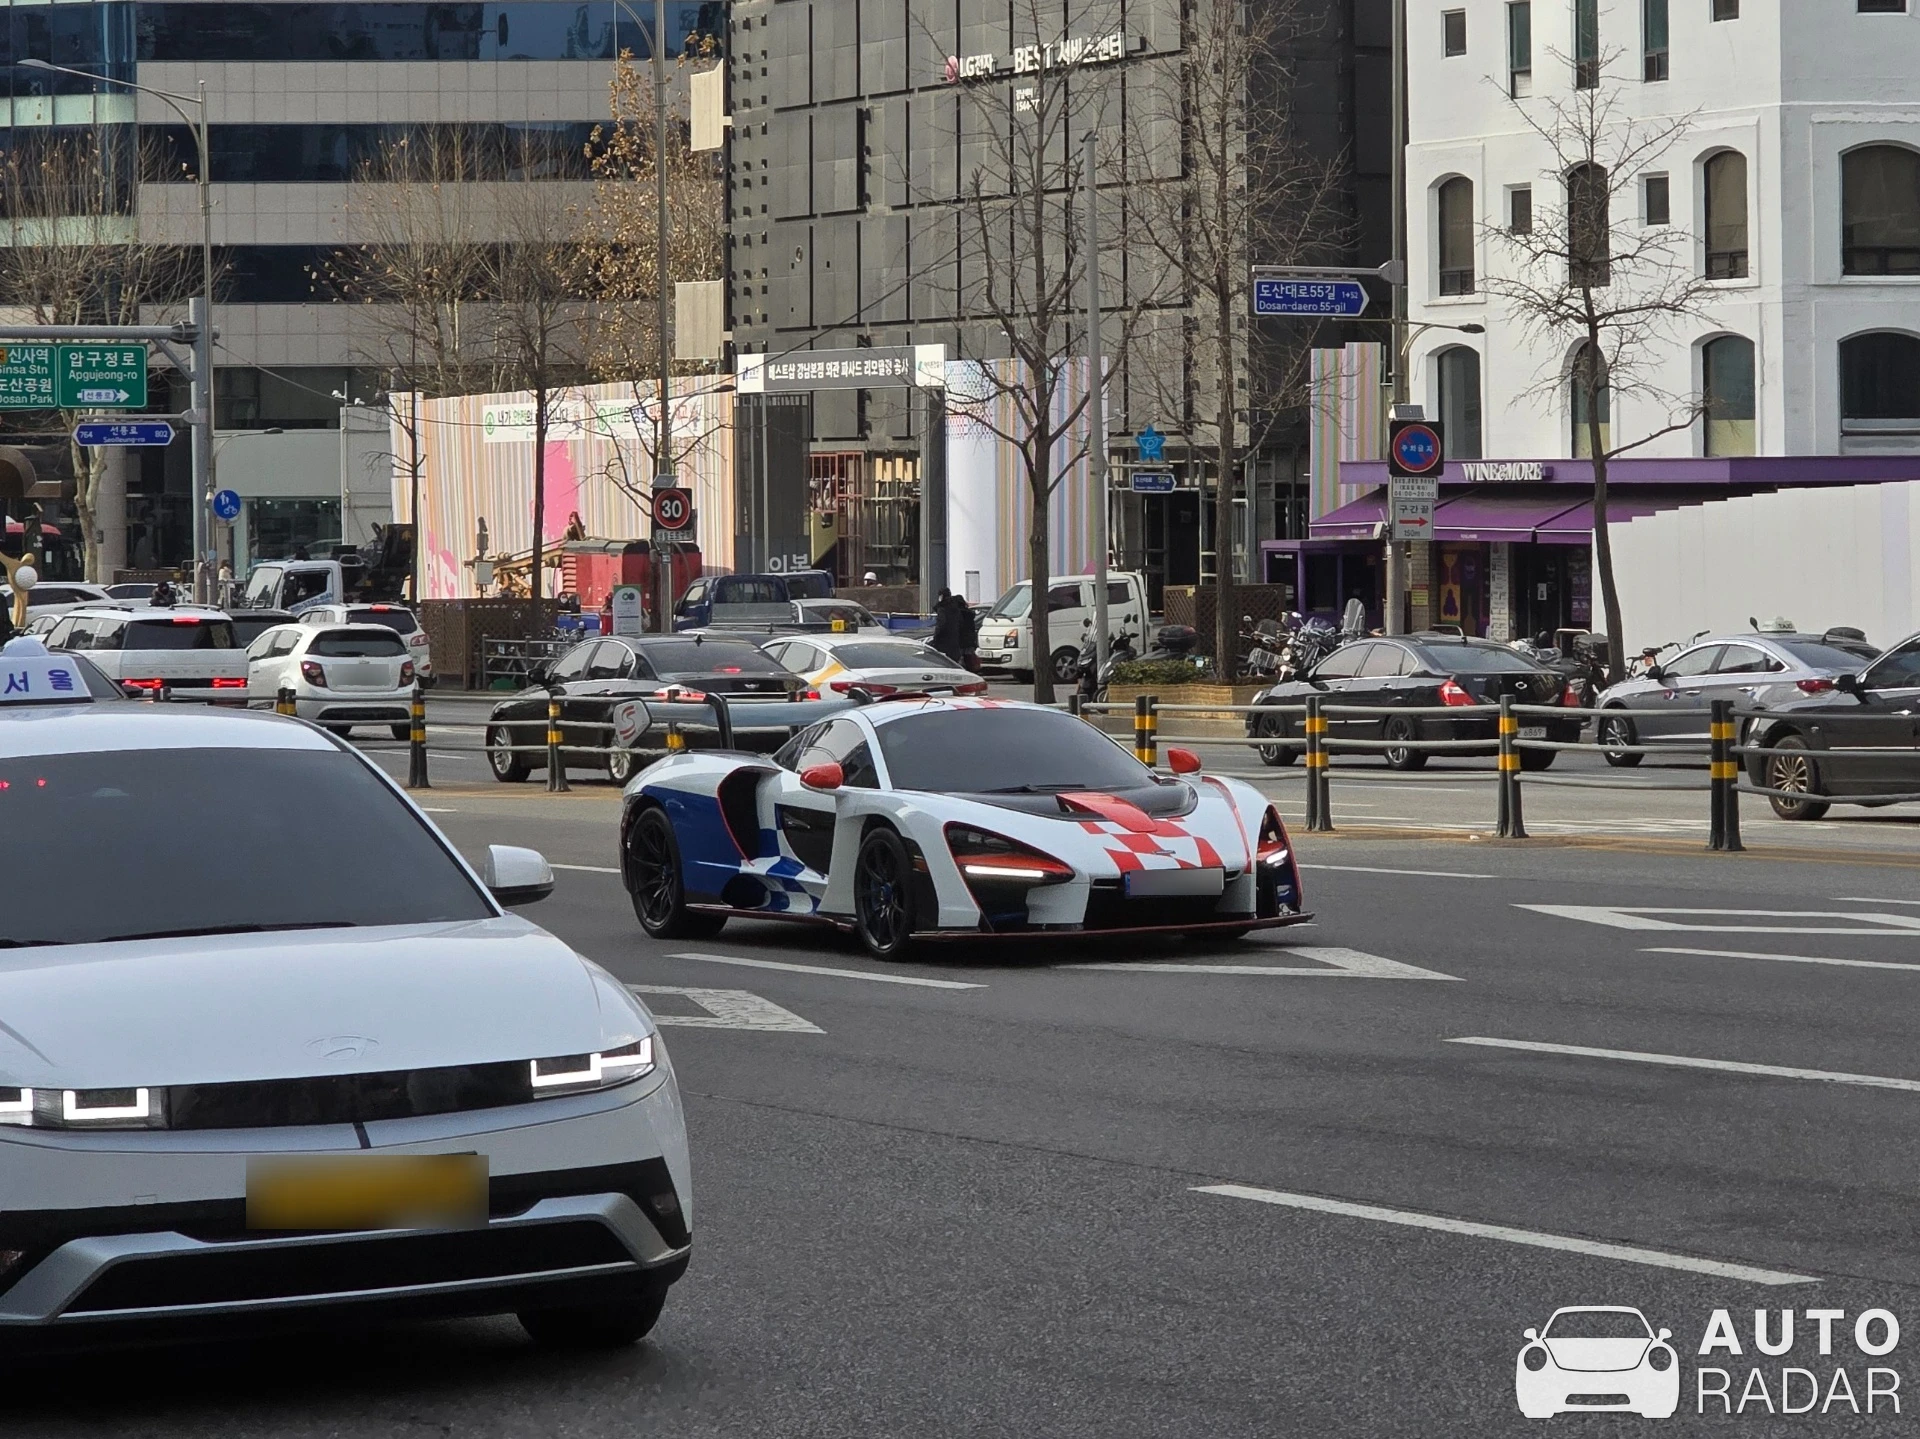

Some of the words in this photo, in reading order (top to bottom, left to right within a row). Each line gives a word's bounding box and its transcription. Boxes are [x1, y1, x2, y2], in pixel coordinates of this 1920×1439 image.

[959, 53, 993, 78] LG전자
[1013, 43, 1054, 73] BEST
[1057, 31, 1124, 66] 서비스센터
[1259, 284, 1336, 300] 도산대로55길
[1259, 300, 1318, 311] Dosan-daero
[1319, 302, 1347, 313] 55-gil
[8, 348, 49, 364] 신사역
[69, 351, 137, 368] 압구정로
[29, 364, 48, 374] Stn
[68, 369, 138, 382] Apgujeong-ro
[796, 362, 825, 380] 강남본점
[825, 360, 840, 378] 외관
[841, 360, 863, 377] 파사드
[0, 377, 52, 392] 도산공원
[30, 394, 53, 404] Park
[86, 391, 112, 400] 선릉로
[498, 410, 511, 425] 내가
[110, 425, 138, 436] 선릉로
[155, 430, 168, 438] 802
[1402, 444, 1433, 453] 주차금지
[1461, 462, 1543, 481] WINE&MORE
[661, 499, 683, 518] 30
[1420, 504, 1429, 515] 끝
[1403, 529, 1421, 538] 150m
[3, 668, 74, 695] 서울
